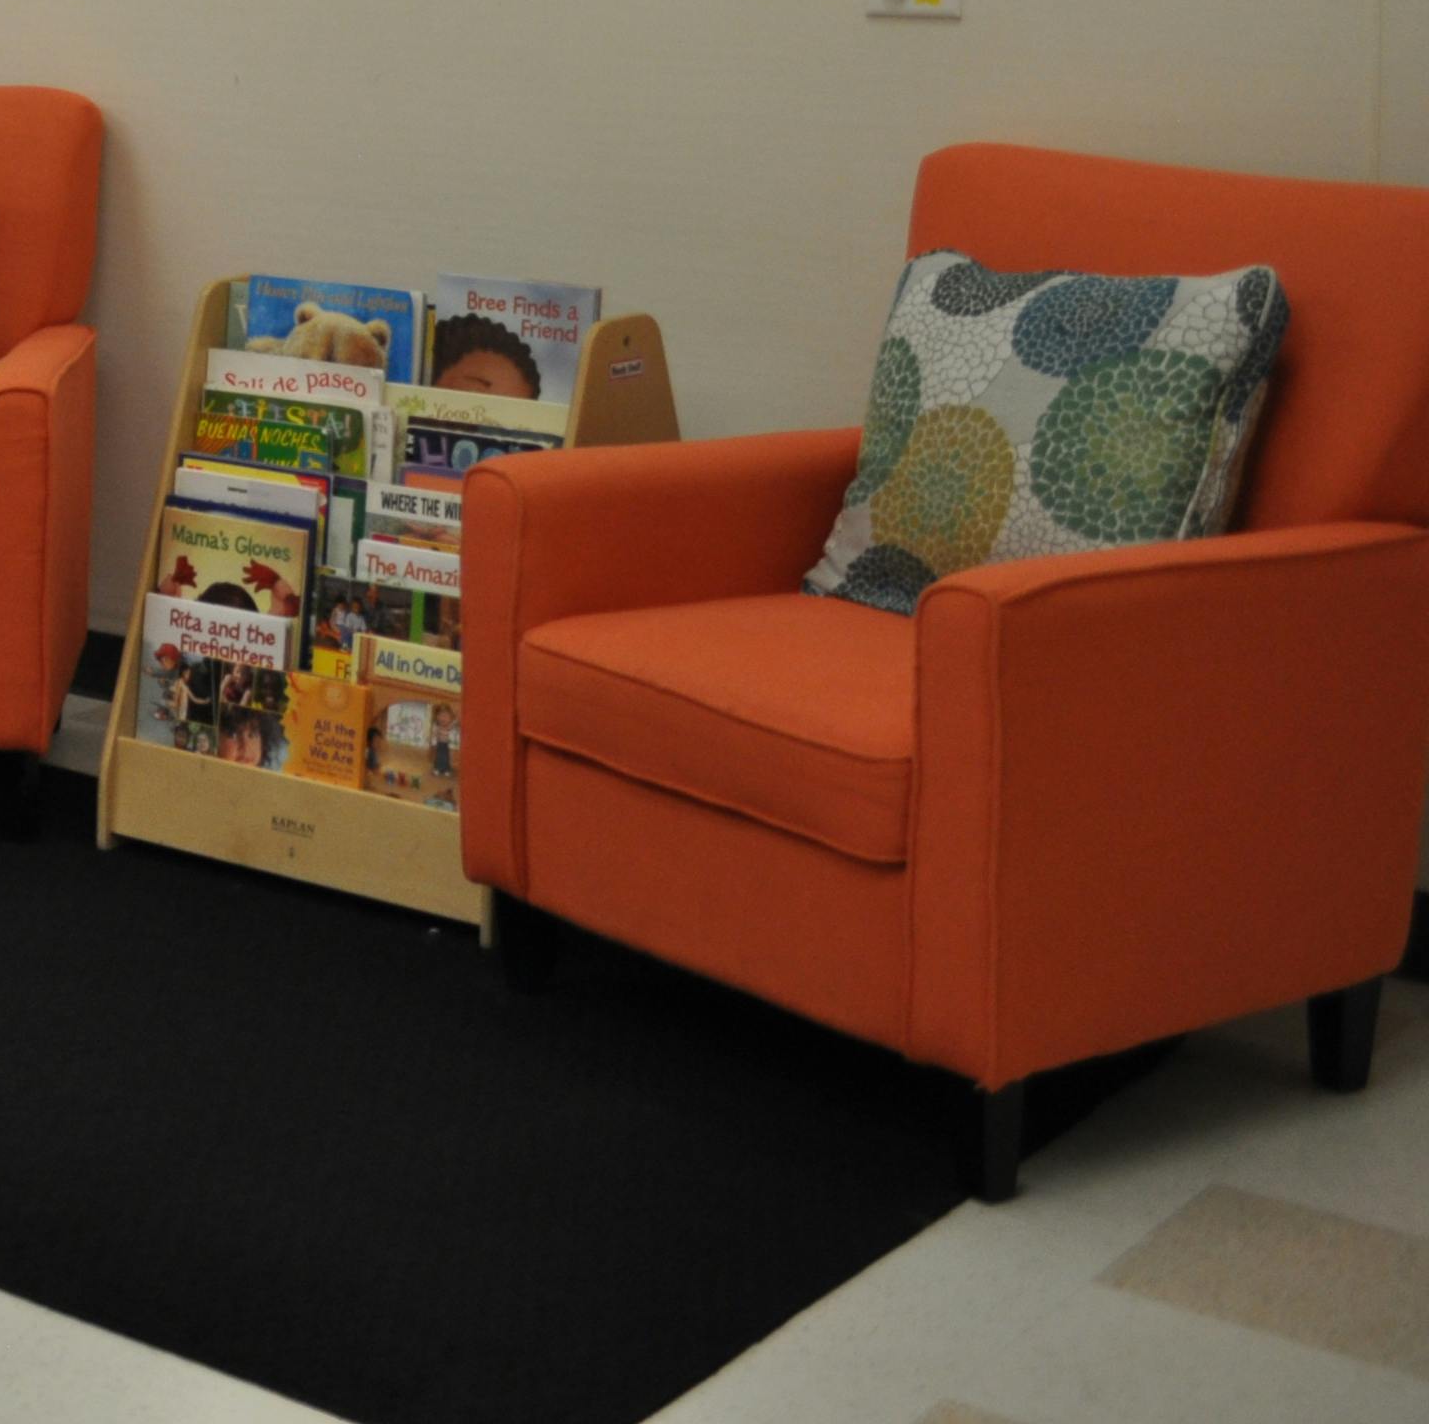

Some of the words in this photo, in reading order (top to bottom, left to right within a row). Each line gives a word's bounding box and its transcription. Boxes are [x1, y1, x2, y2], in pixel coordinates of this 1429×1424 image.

[467, 291, 506, 312] Bree
[513, 296, 560, 318] Finds
[568, 306, 579, 321] a
[520, 321, 578, 343] Friend
[273, 377, 298, 392] de
[306, 372, 367, 397] paseo
[197, 420, 258, 443] BUENAS
[260, 426, 321, 451] NOCHES
[381, 491, 418, 514] WHERE
[421, 497, 441, 517] THE
[172, 523, 229, 551] Mama's
[235, 536, 291, 562] Gloves
[366, 552, 397, 576] The
[170, 609, 202, 632] Rita
[208, 620, 240, 640] and
[247, 624, 275, 646] the
[181, 634, 274, 668] Firefighters
[376, 650, 394, 671] All
[397, 655, 410, 672] in
[413, 658, 443, 679] One
